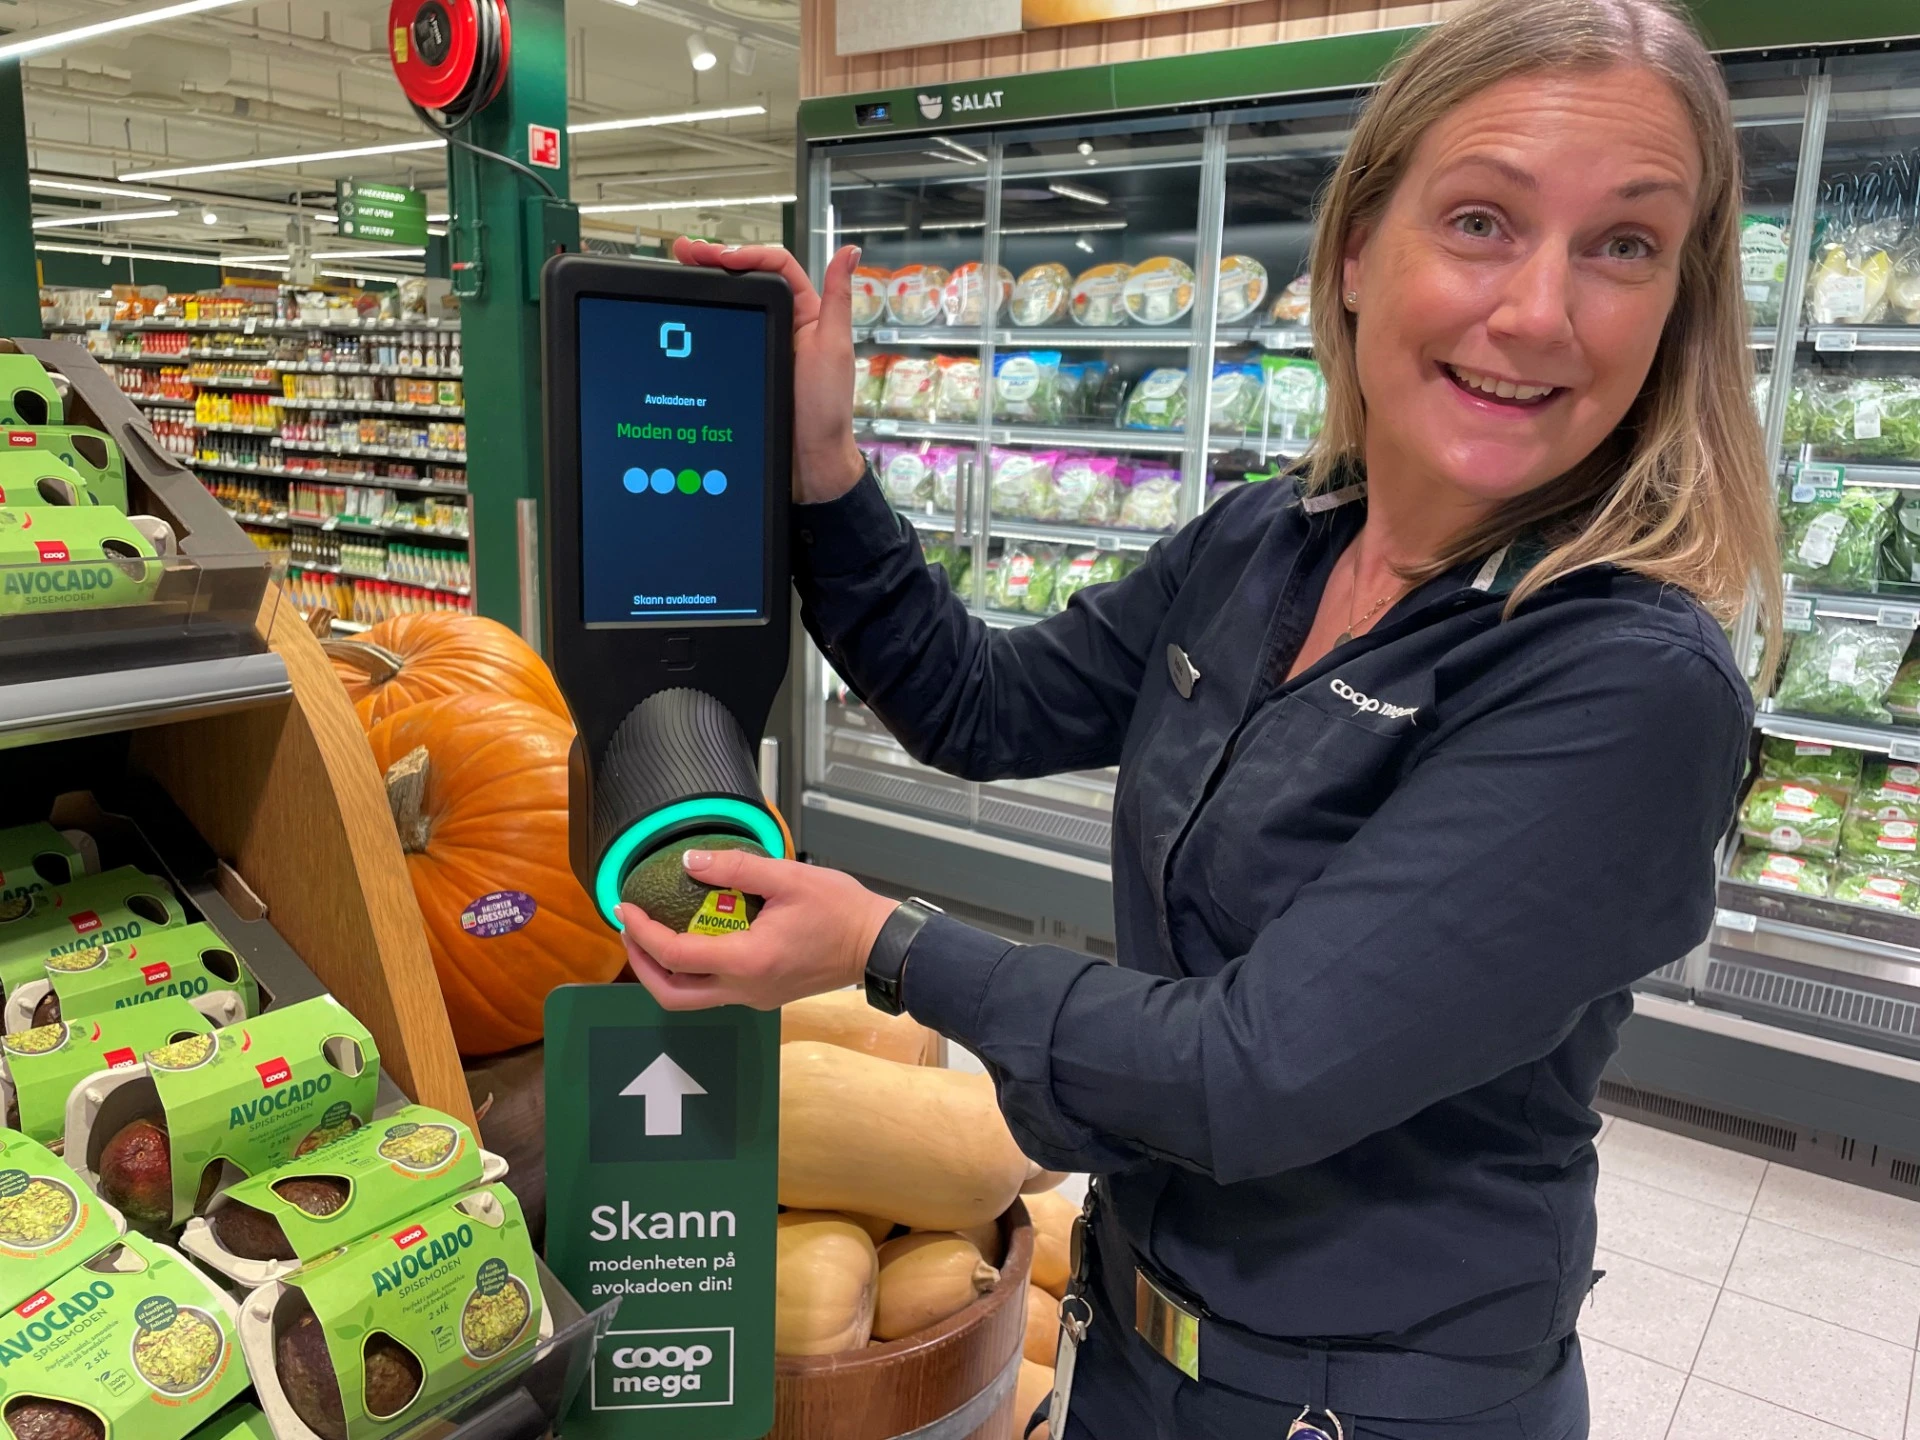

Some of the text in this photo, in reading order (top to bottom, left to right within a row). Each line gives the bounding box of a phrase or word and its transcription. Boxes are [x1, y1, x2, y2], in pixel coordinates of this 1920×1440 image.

[951, 91, 1004, 112] SALAT
[645, 394, 707, 406] Avokadoen er
[617, 423, 733, 444] Moden og fast
[43, 551, 65, 559] coop
[4, 568, 113, 595] AVOCADO
[25, 592, 95, 605] SPISEMODEN
[633, 594, 717, 605] Skann avokadoen
[1330, 678, 1380, 712] coop
[79, 919, 97, 930] coop
[477, 906, 520, 925] GRESSKAR
[697, 914, 747, 931] AVOKADO
[148, 971, 168, 981] coop
[266, 1070, 288, 1083] coop
[229, 1073, 332, 1130] AVOCADO
[249, 1100, 314, 1132] SPISEMODEN
[590, 1200, 736, 1242] Skann
[400, 1230, 422, 1244] coop
[371, 1223, 473, 1298] AVOCADO
[589, 1251, 736, 1272] modenheten på
[398, 1256, 462, 1299] SPISEMODEN
[591, 1276, 733, 1295] avokadoen din!
[22, 1295, 48, 1313] coop
[143, 1300, 158, 1310] Kilde
[145, 1301, 172, 1316] kostfiber,
[428, 1301, 449, 1320] 2 stk
[0, 1280, 115, 1368] AVOCADO
[145, 1312, 164, 1325] kalium
[150, 1313, 176, 1330] folinsyre
[33, 1308, 108, 1361] SPISEMODEN
[45, 1353, 69, 1372] Perfekt
[73, 1340, 91, 1353] salat,
[91, 1320, 119, 1341] smoothie
[64, 1360, 73, 1369] og
[81, 1333, 113, 1355] brødskive
[84, 1348, 111, 1370] 2 stk
[612, 1345, 713, 1371] coop
[108, 1373, 127, 1387] 100%
[613, 1373, 701, 1398] mega
